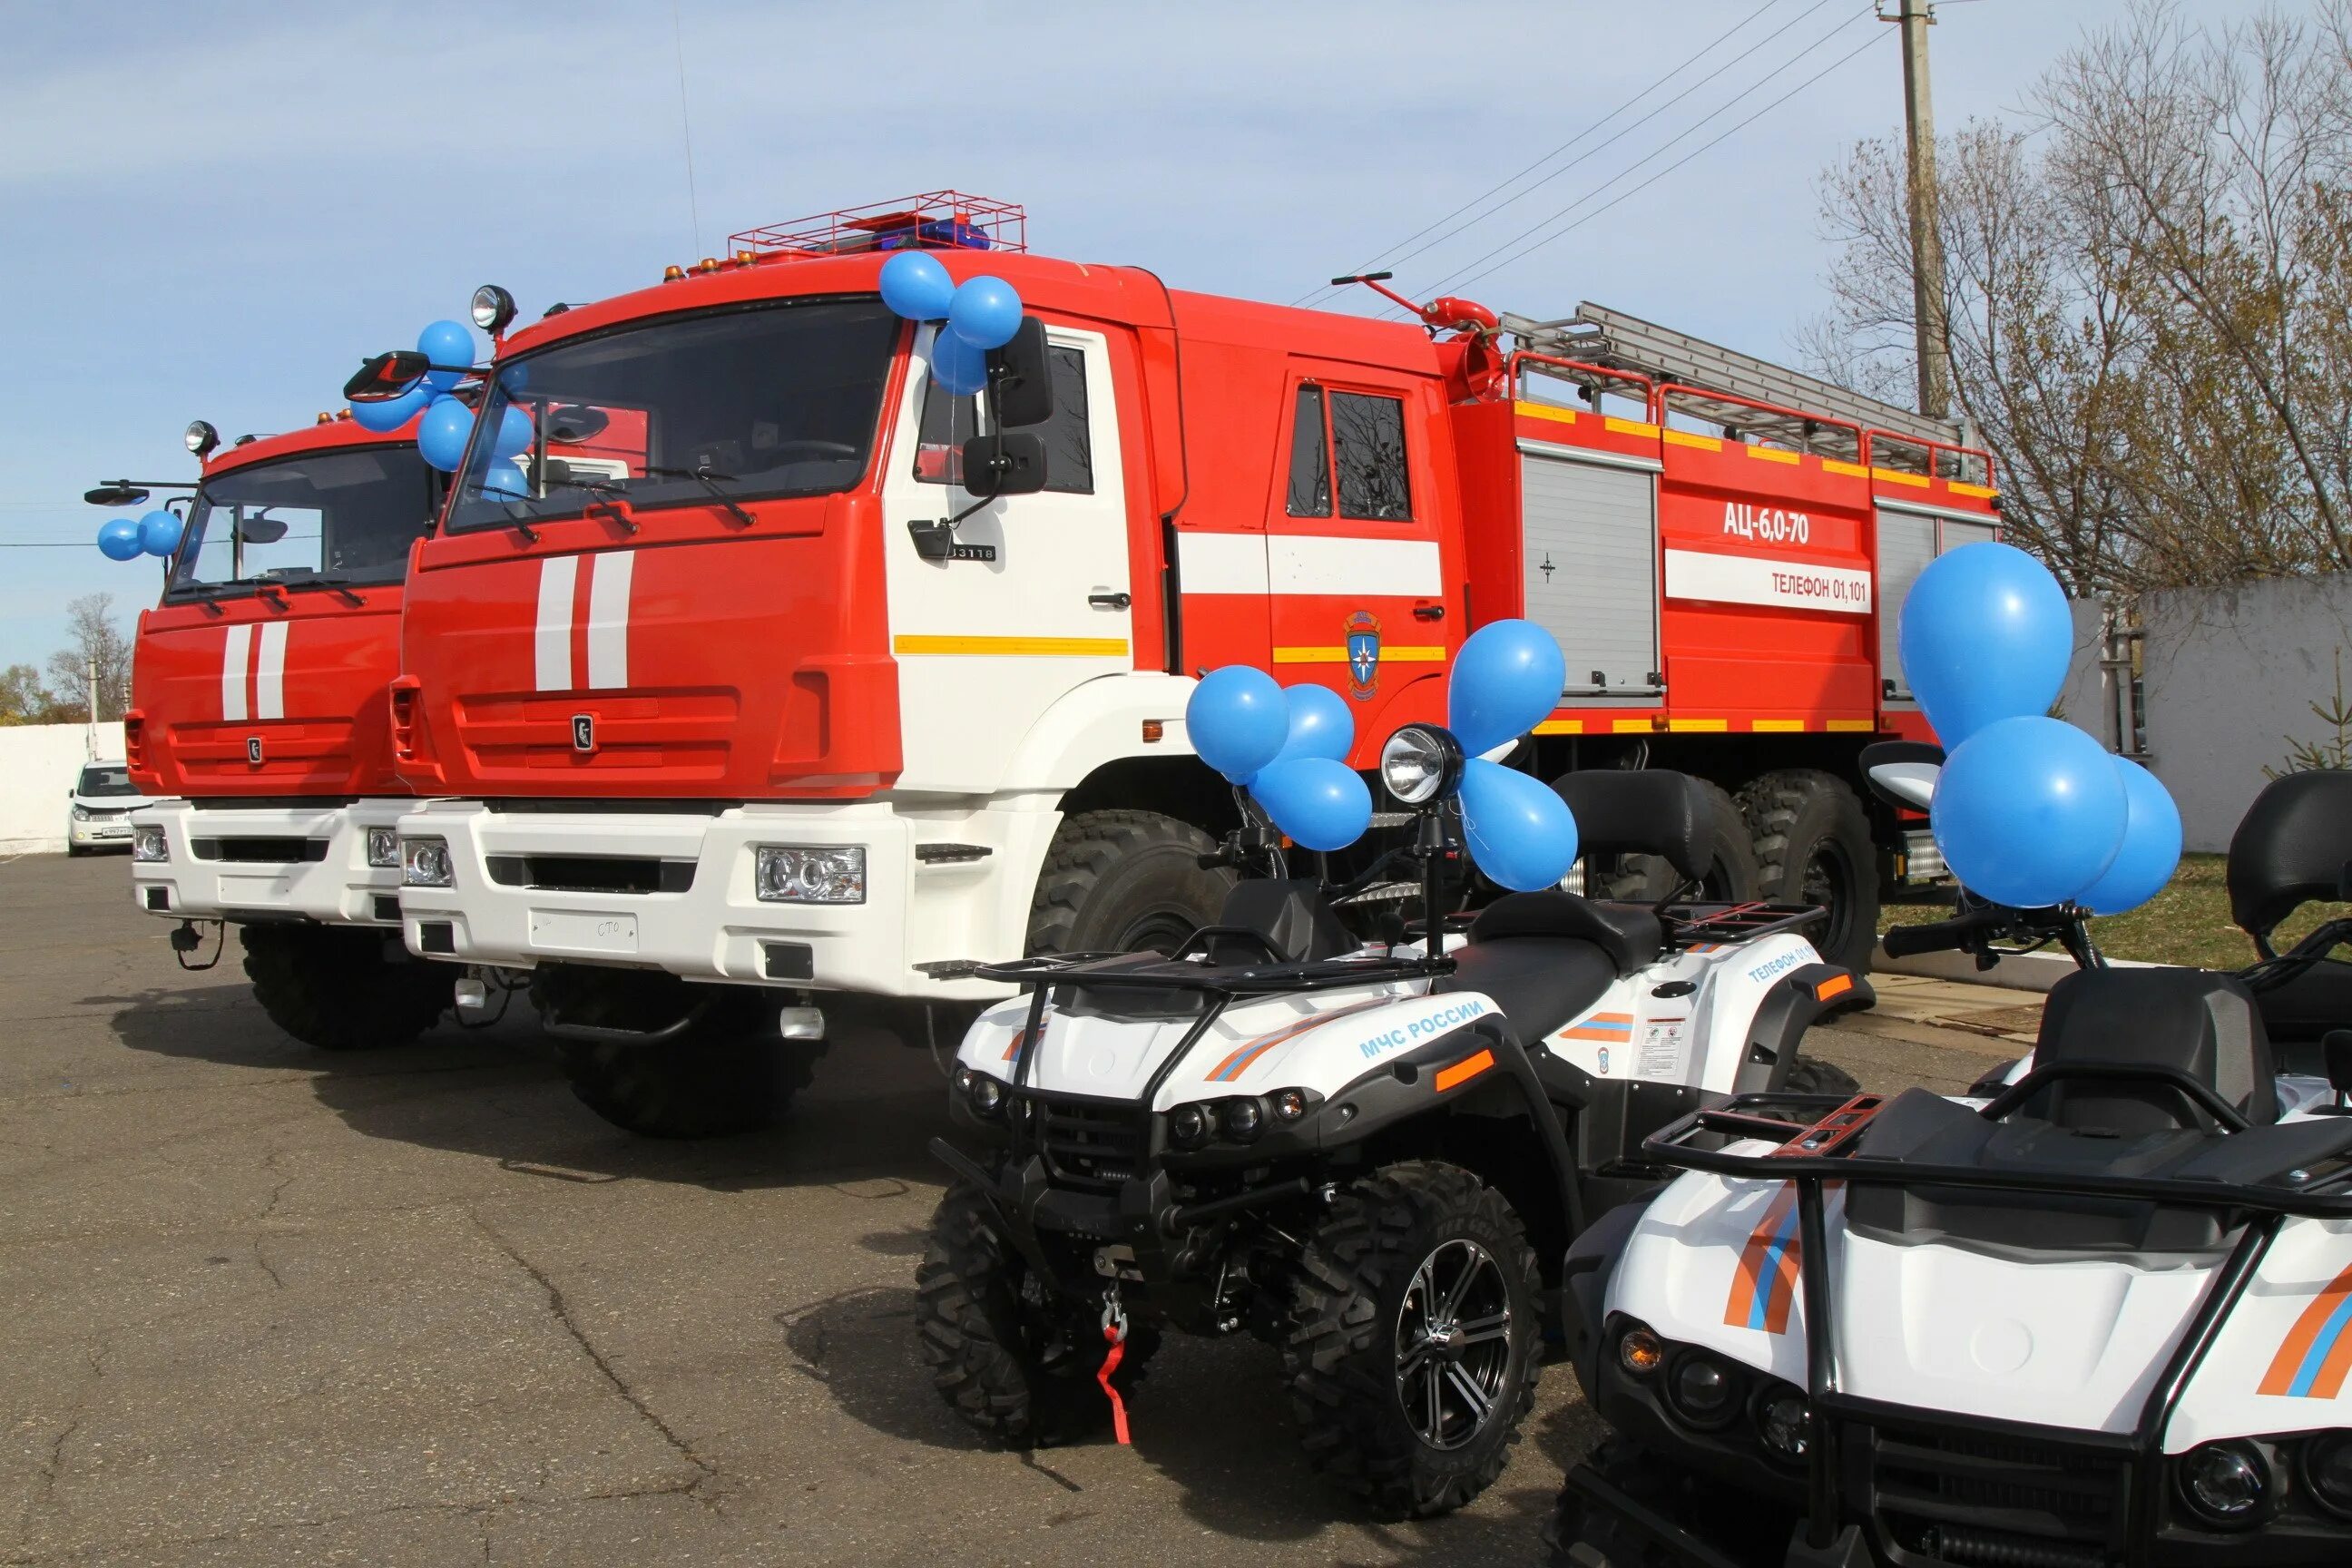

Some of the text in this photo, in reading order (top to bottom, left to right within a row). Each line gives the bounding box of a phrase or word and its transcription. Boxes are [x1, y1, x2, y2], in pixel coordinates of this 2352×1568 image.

[1723, 502, 1809, 544] АЦ-6,0-70
[1771, 572, 1867, 603] ТЕЛЕФОН 01,101
[1748, 951, 1798, 983] ТЕЛЕФОН
[1358, 1000, 1485, 1059] МЧС РОССИИ
